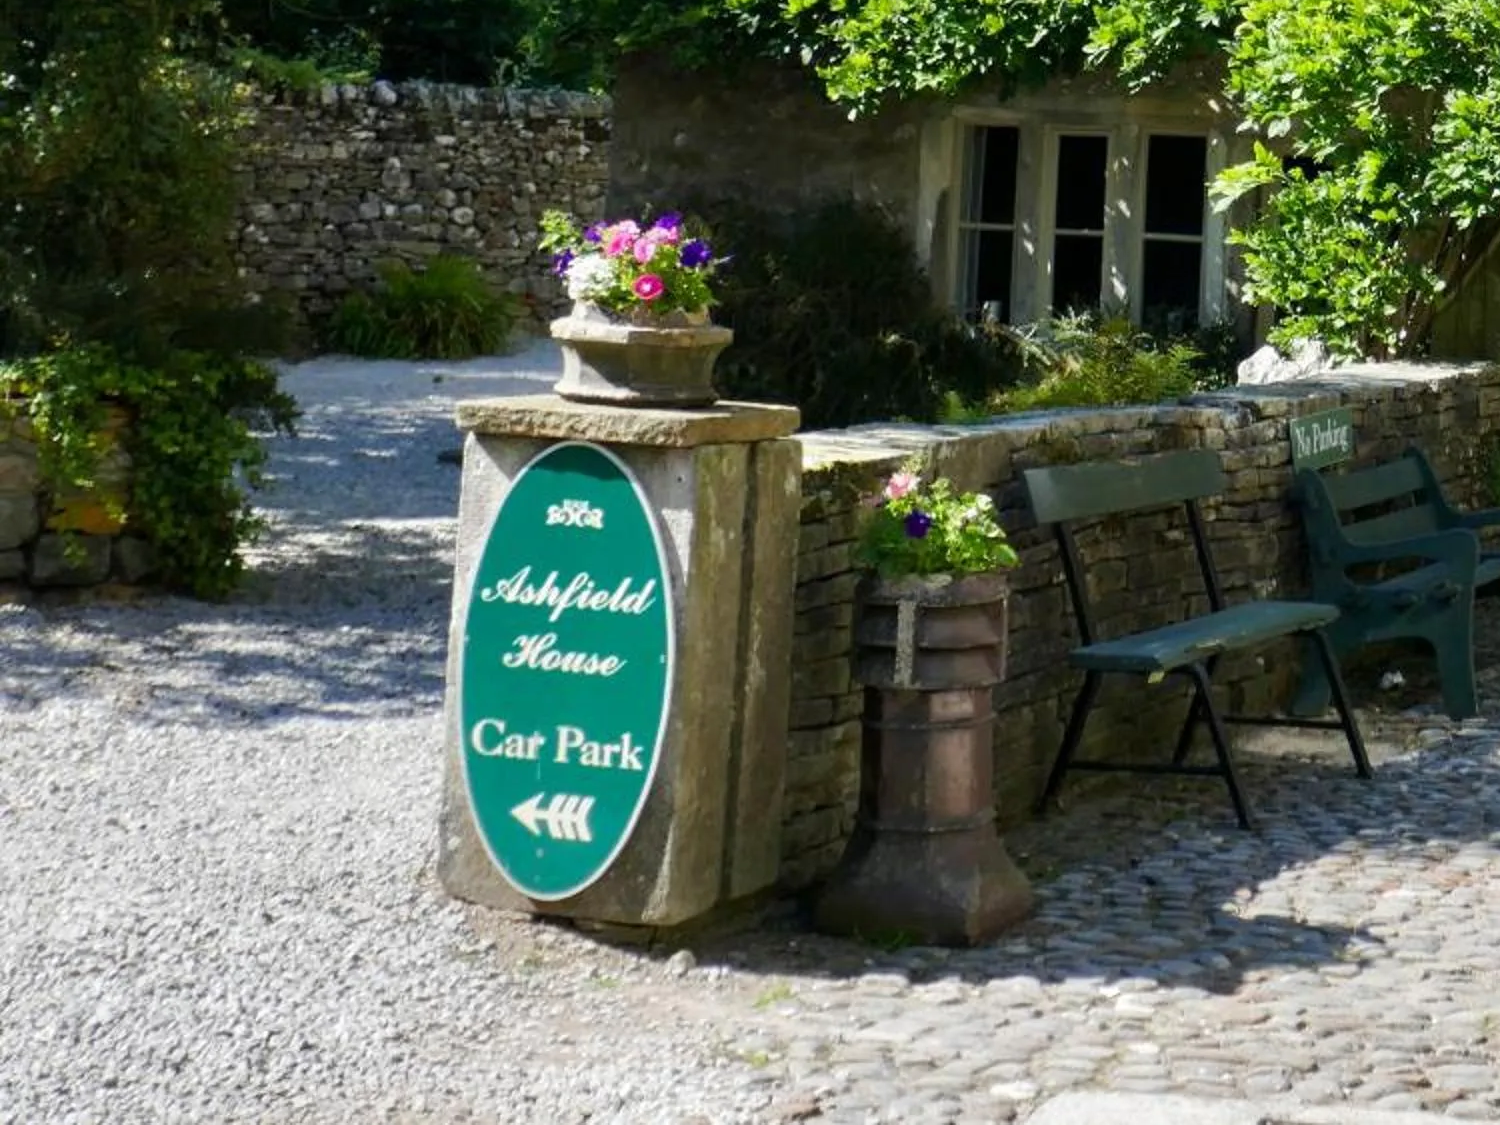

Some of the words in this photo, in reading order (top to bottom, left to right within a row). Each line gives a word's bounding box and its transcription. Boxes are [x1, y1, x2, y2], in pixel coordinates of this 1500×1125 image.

[1294, 426, 1312, 459] No
[1312, 418, 1349, 454] Parking
[481, 565, 656, 622] Ashfield
[502, 632, 626, 677] House
[471, 717, 545, 760] Car
[553, 725, 644, 771] Park
